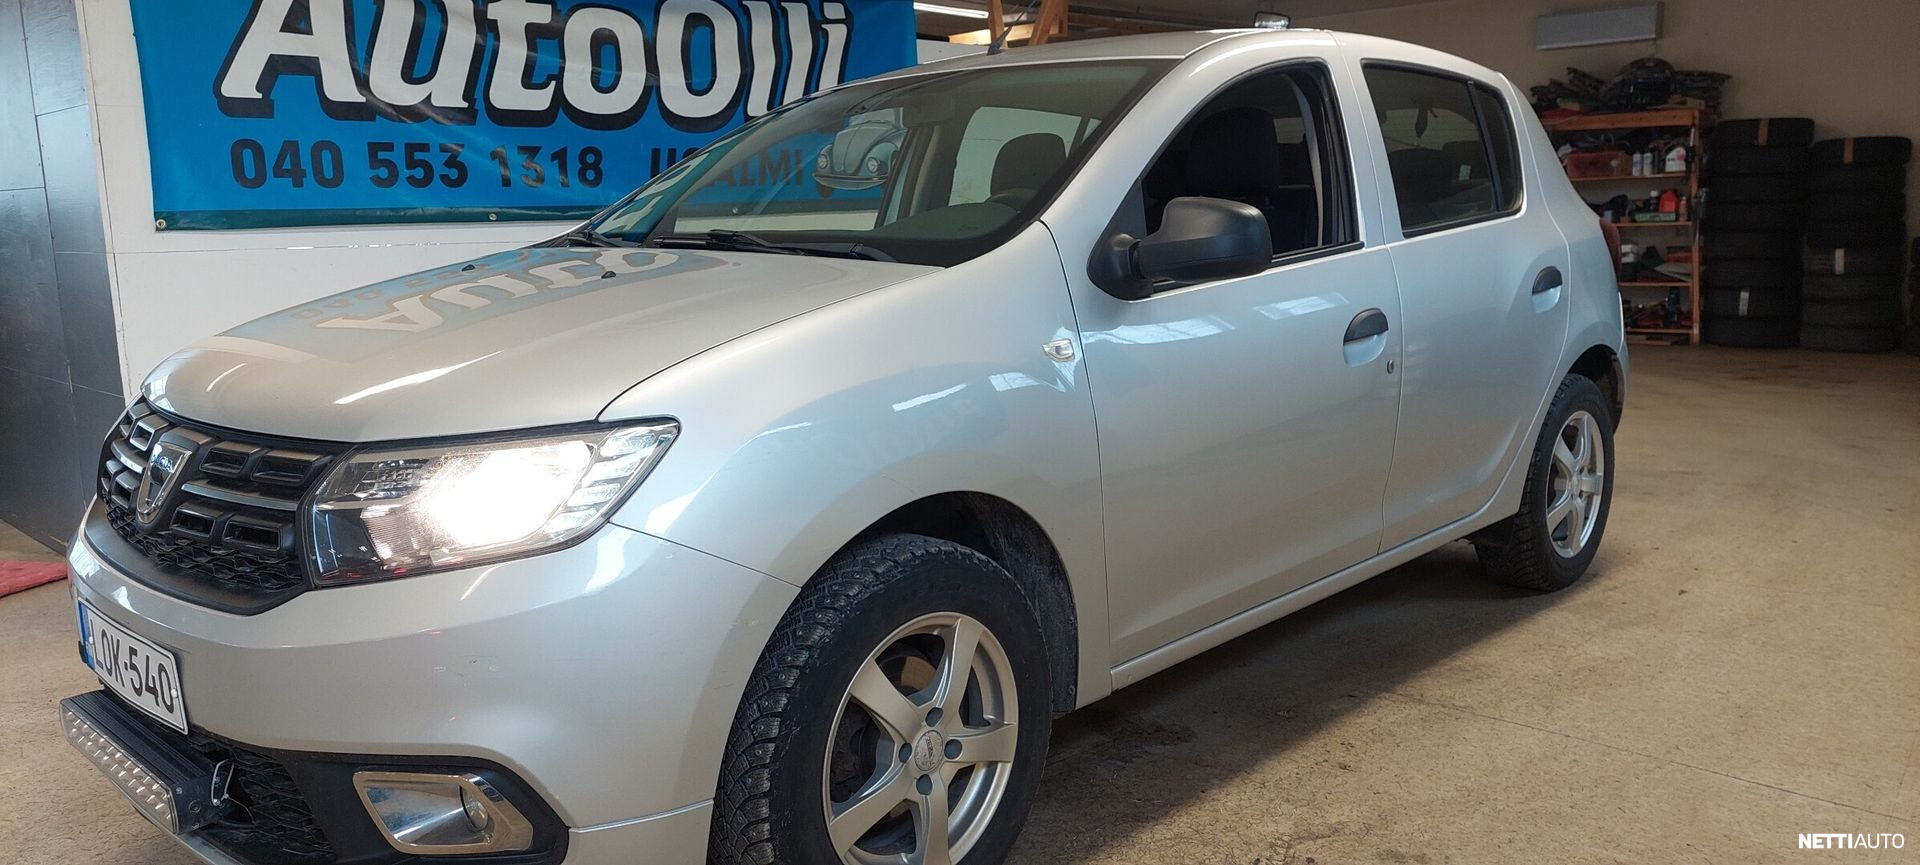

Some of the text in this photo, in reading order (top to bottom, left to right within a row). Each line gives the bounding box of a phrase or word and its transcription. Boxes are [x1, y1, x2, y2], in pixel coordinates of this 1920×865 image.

[230, 138, 345, 189] 040
[367, 141, 469, 189] 553
[489, 143, 603, 189] 1318
[90, 619, 175, 714] LOK-540
